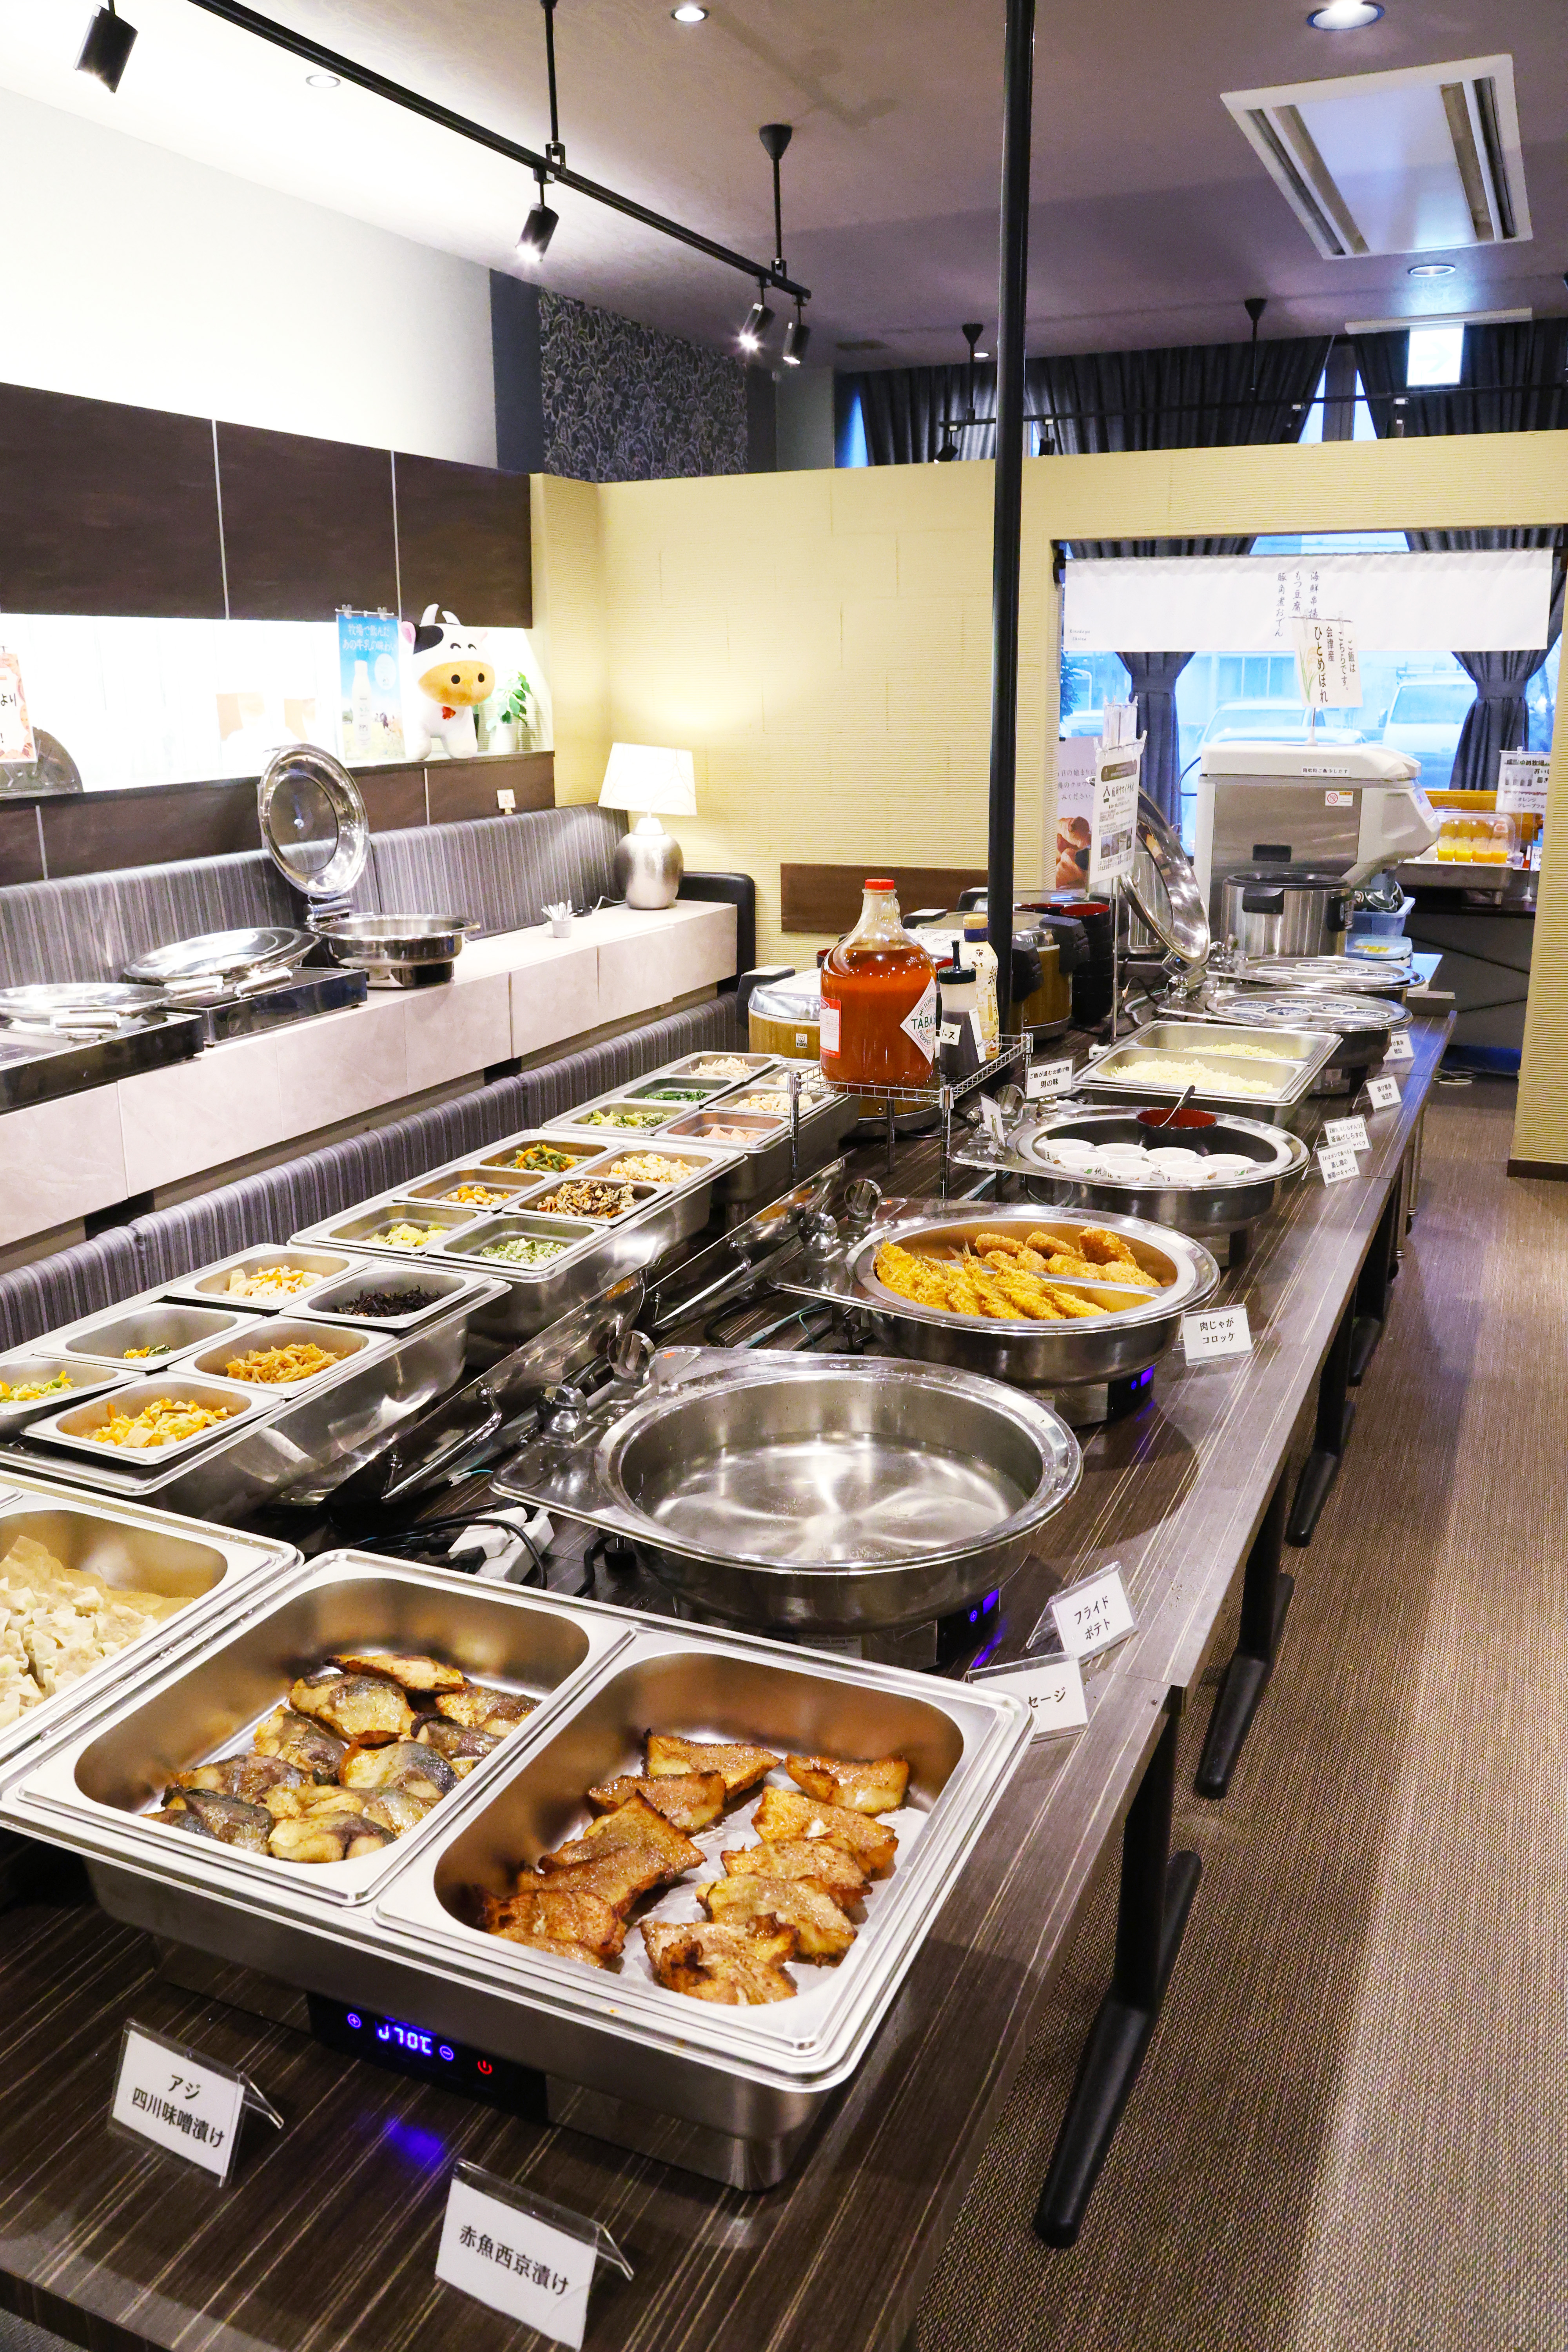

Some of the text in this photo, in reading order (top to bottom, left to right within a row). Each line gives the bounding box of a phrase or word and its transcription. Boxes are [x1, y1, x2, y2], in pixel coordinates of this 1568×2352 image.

[1326, 626, 1335, 662] 会津産
[1348, 639, 1356, 673] ご飯は
[1315, 627, 1328, 703] ひとめぼれ
[1029, 1066, 1070, 1079] ご飯が進むお漬け物
[1040, 1078, 1058, 1089] 男の味
[1200, 1317, 1234, 1331] 肉じゃが
[1203, 1332, 1235, 1344] コロッケ
[1074, 1596, 1109, 1624] フライド
[1085, 1618, 1110, 1640] ポテト
[168, 2074, 201, 2100] アジ
[132, 2087, 225, 2148] 四川味噌漬け
[459, 2225, 569, 2296] 赤魚西京漬け
